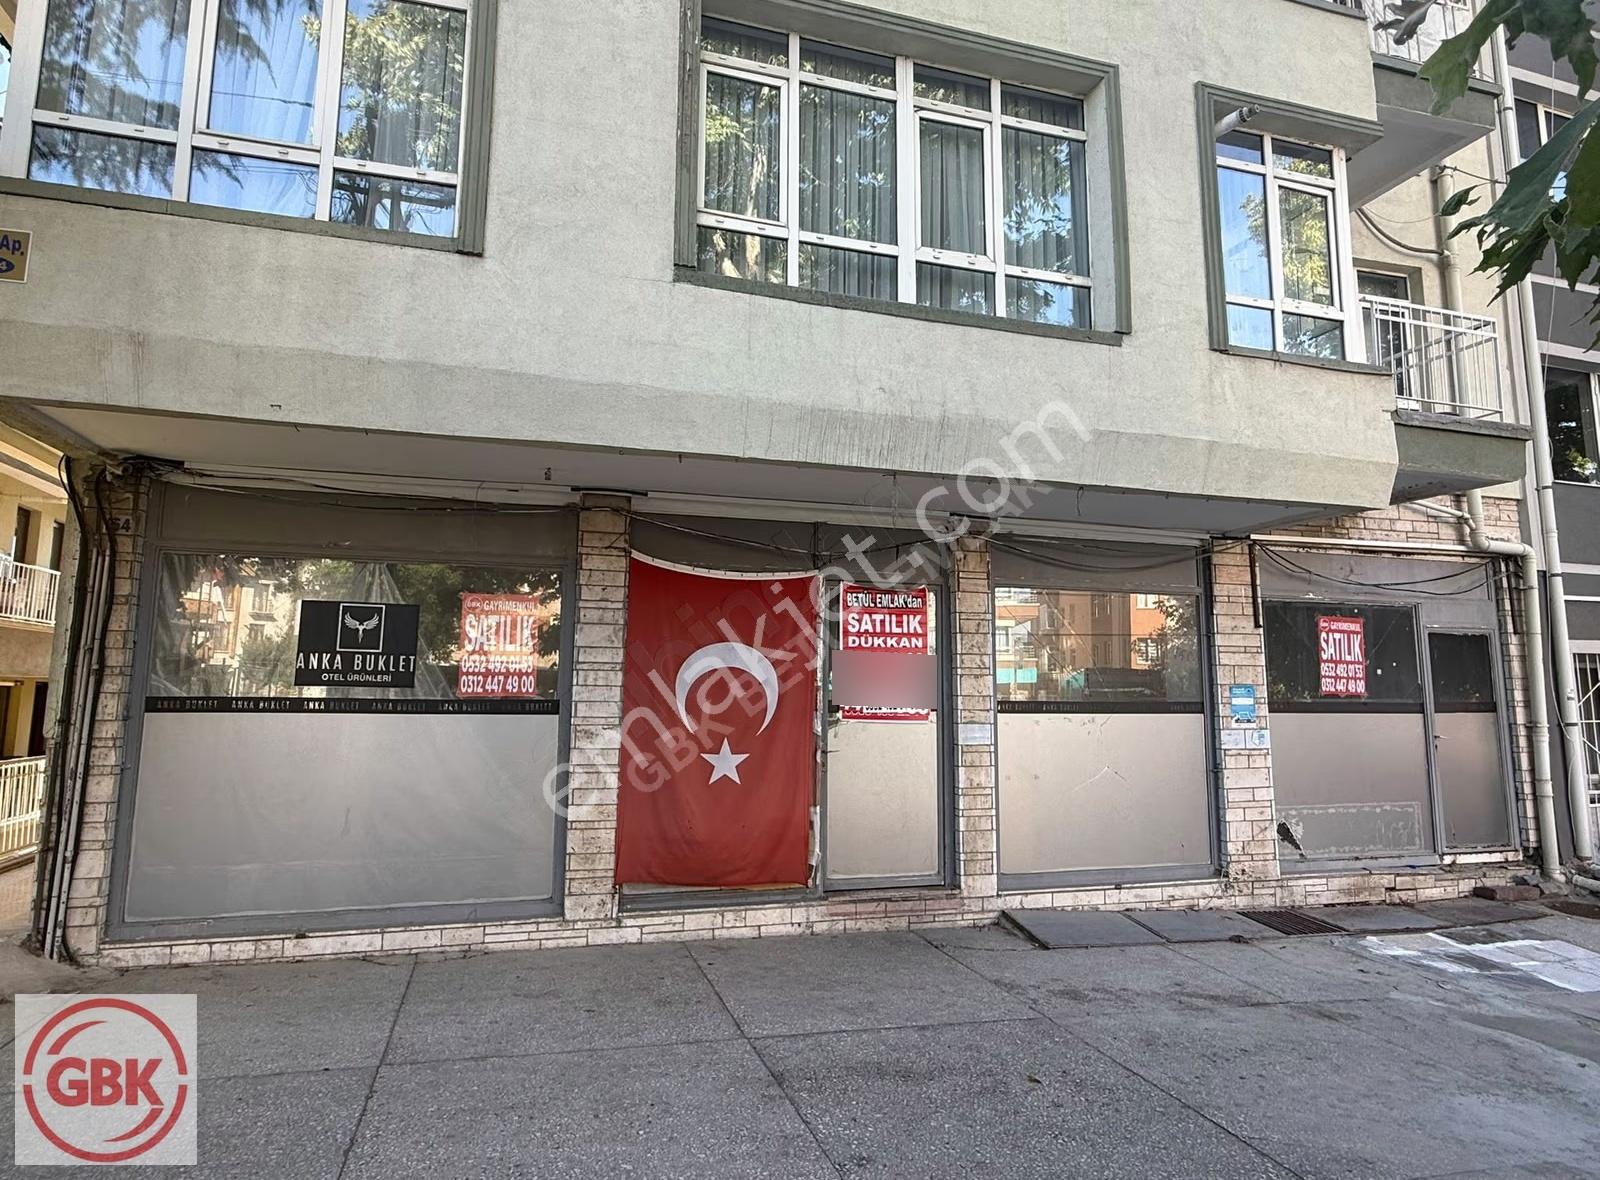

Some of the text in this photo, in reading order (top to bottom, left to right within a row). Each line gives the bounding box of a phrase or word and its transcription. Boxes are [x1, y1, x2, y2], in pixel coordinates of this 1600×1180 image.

[0, 234, 24, 256] Ap.
[847, 591, 874, 607] BETÜL
[848, 612, 922, 633] SATILIK
[464, 613, 535, 652] SATILIK
[848, 634, 922, 648] DÜKKAN
[1321, 632, 1362, 661] SATILIK
[296, 652, 416, 672] ANKA BUKLET
[462, 655, 486, 672] 0532
[322, 673, 392, 682] OTEL ÜRÜNLERİ
[461, 675, 534, 692] 0312 447 49 00
[1356, 680, 1365, 693] 00
[303, 700, 326, 710] ANKA
